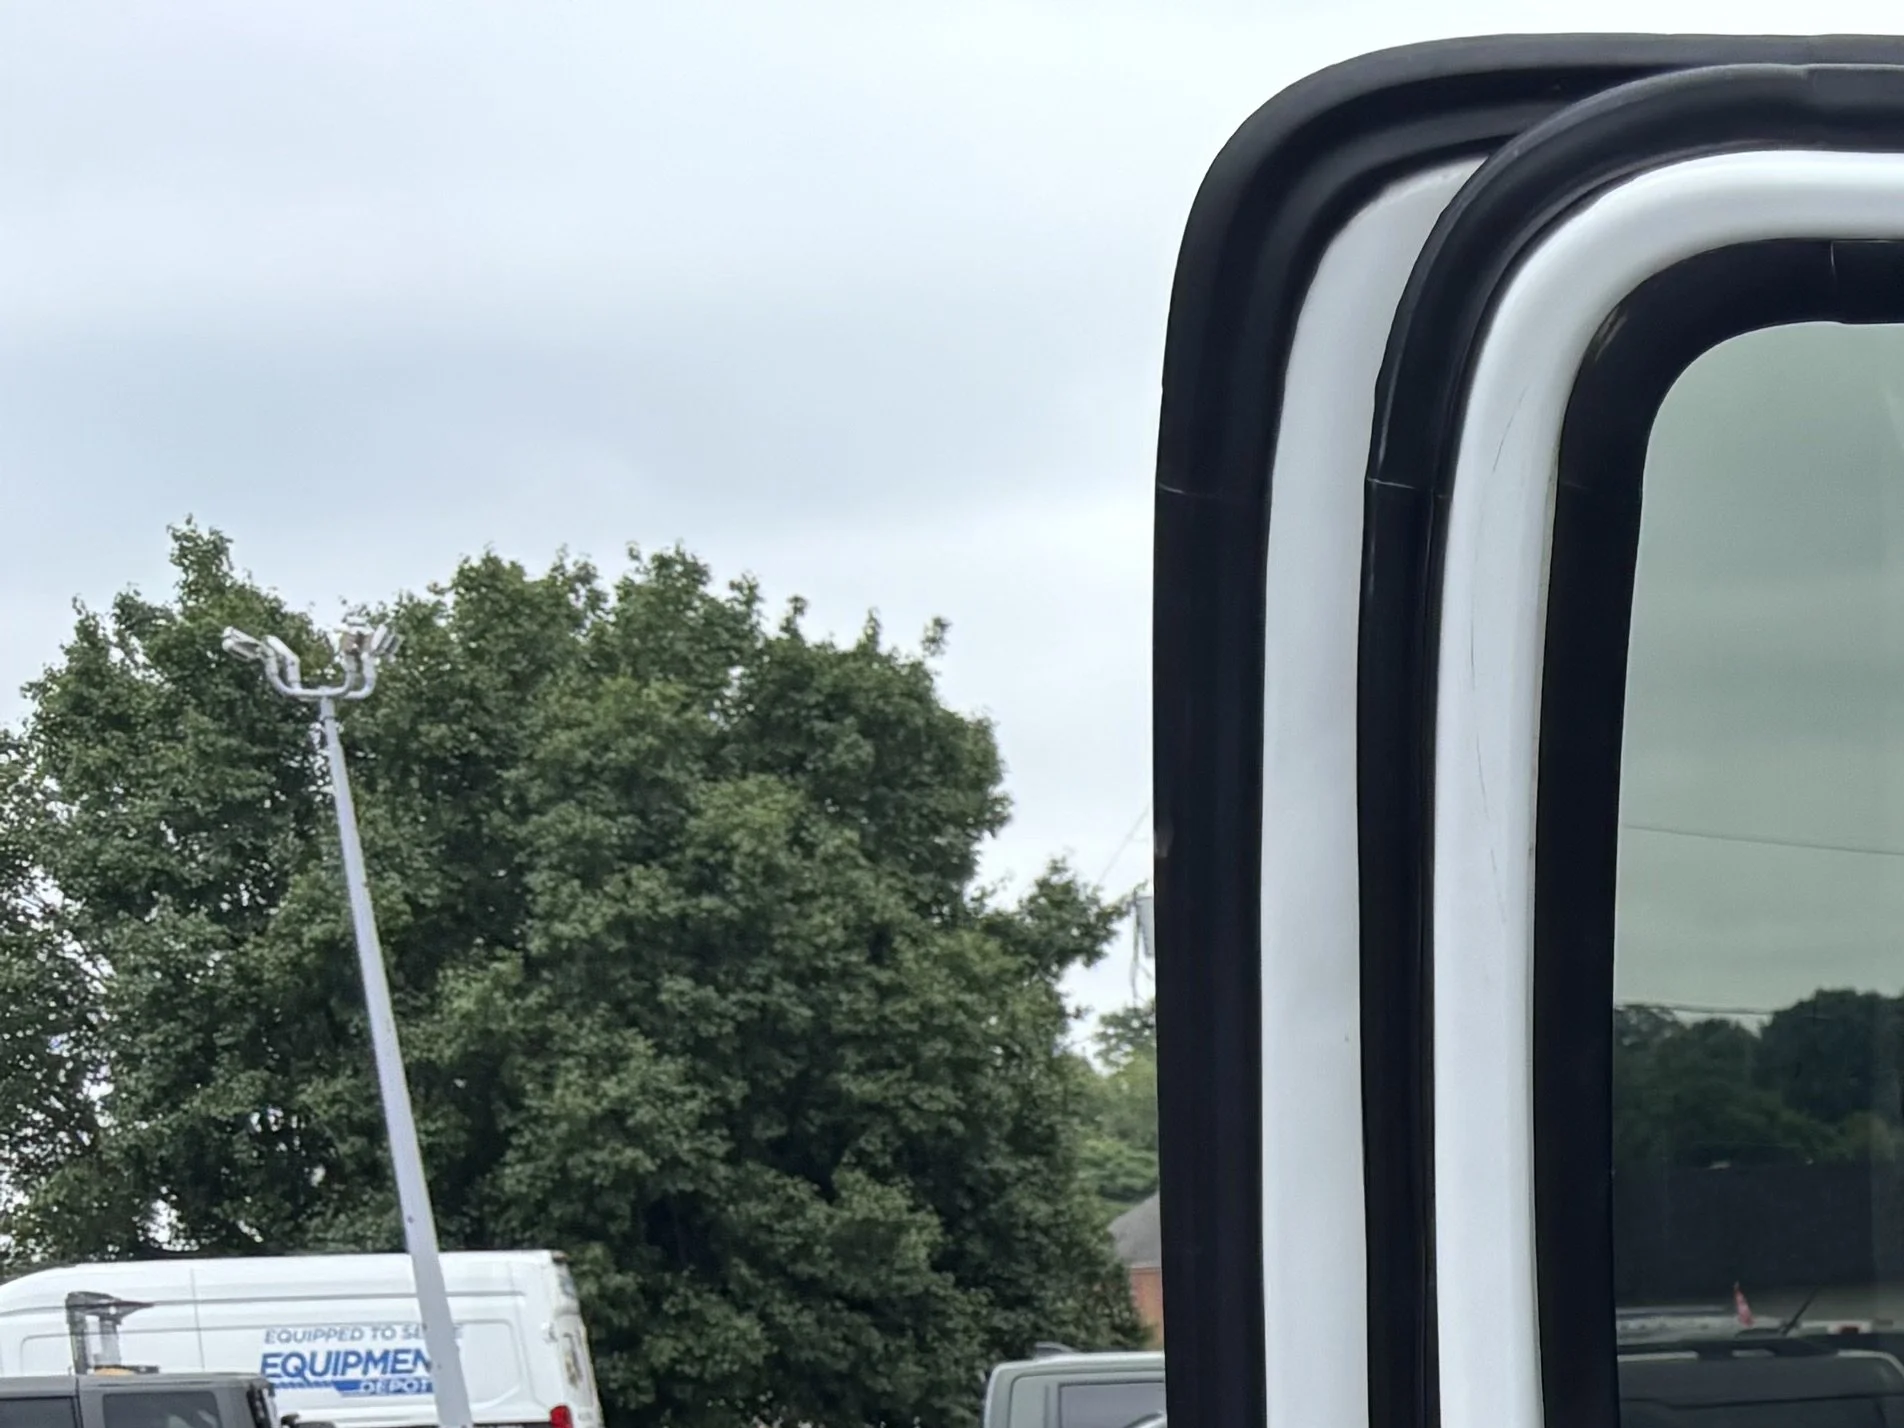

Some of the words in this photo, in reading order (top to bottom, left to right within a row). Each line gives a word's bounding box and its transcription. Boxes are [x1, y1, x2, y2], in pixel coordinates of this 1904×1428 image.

[264, 1327, 364, 1344] EQUIPPED
[372, 1326, 396, 1341] TO
[261, 1348, 431, 1381] EQUIPMEN
